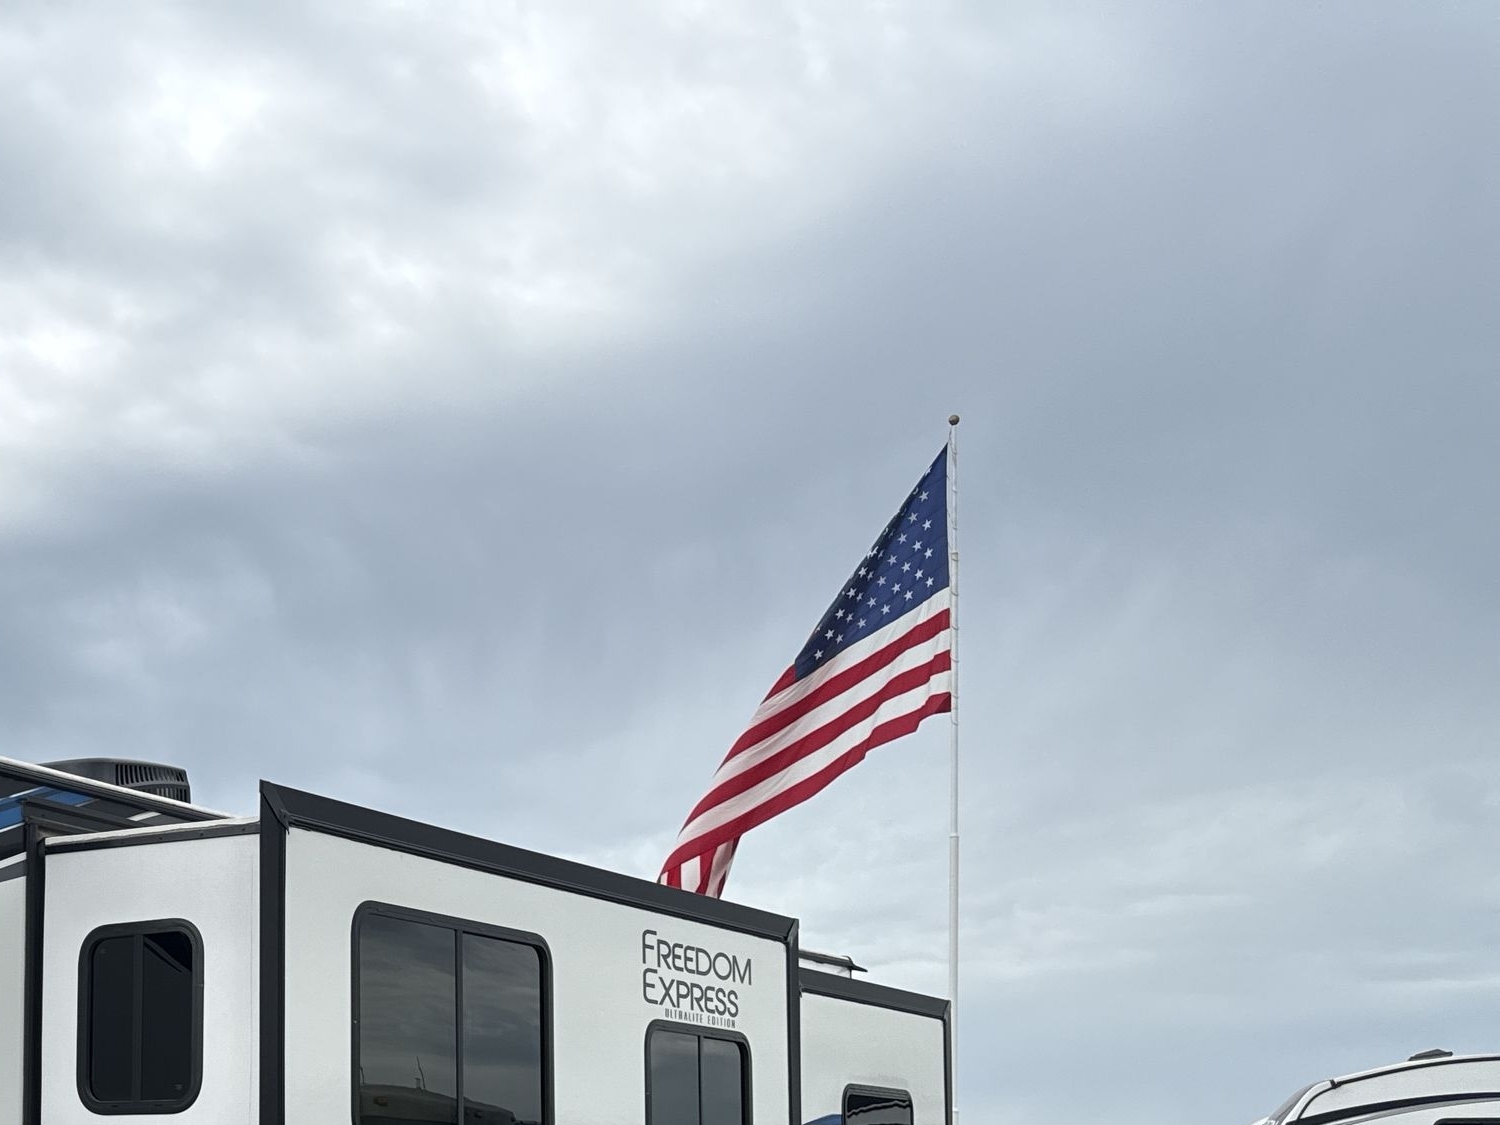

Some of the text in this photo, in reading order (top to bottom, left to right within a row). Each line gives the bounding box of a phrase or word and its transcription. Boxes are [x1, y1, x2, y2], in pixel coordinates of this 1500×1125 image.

[642, 929, 752, 986] FREEDOM
[643, 967, 739, 1018] EXPRESS
[664, 1008, 736, 1029] ULTRALITE EDITION
